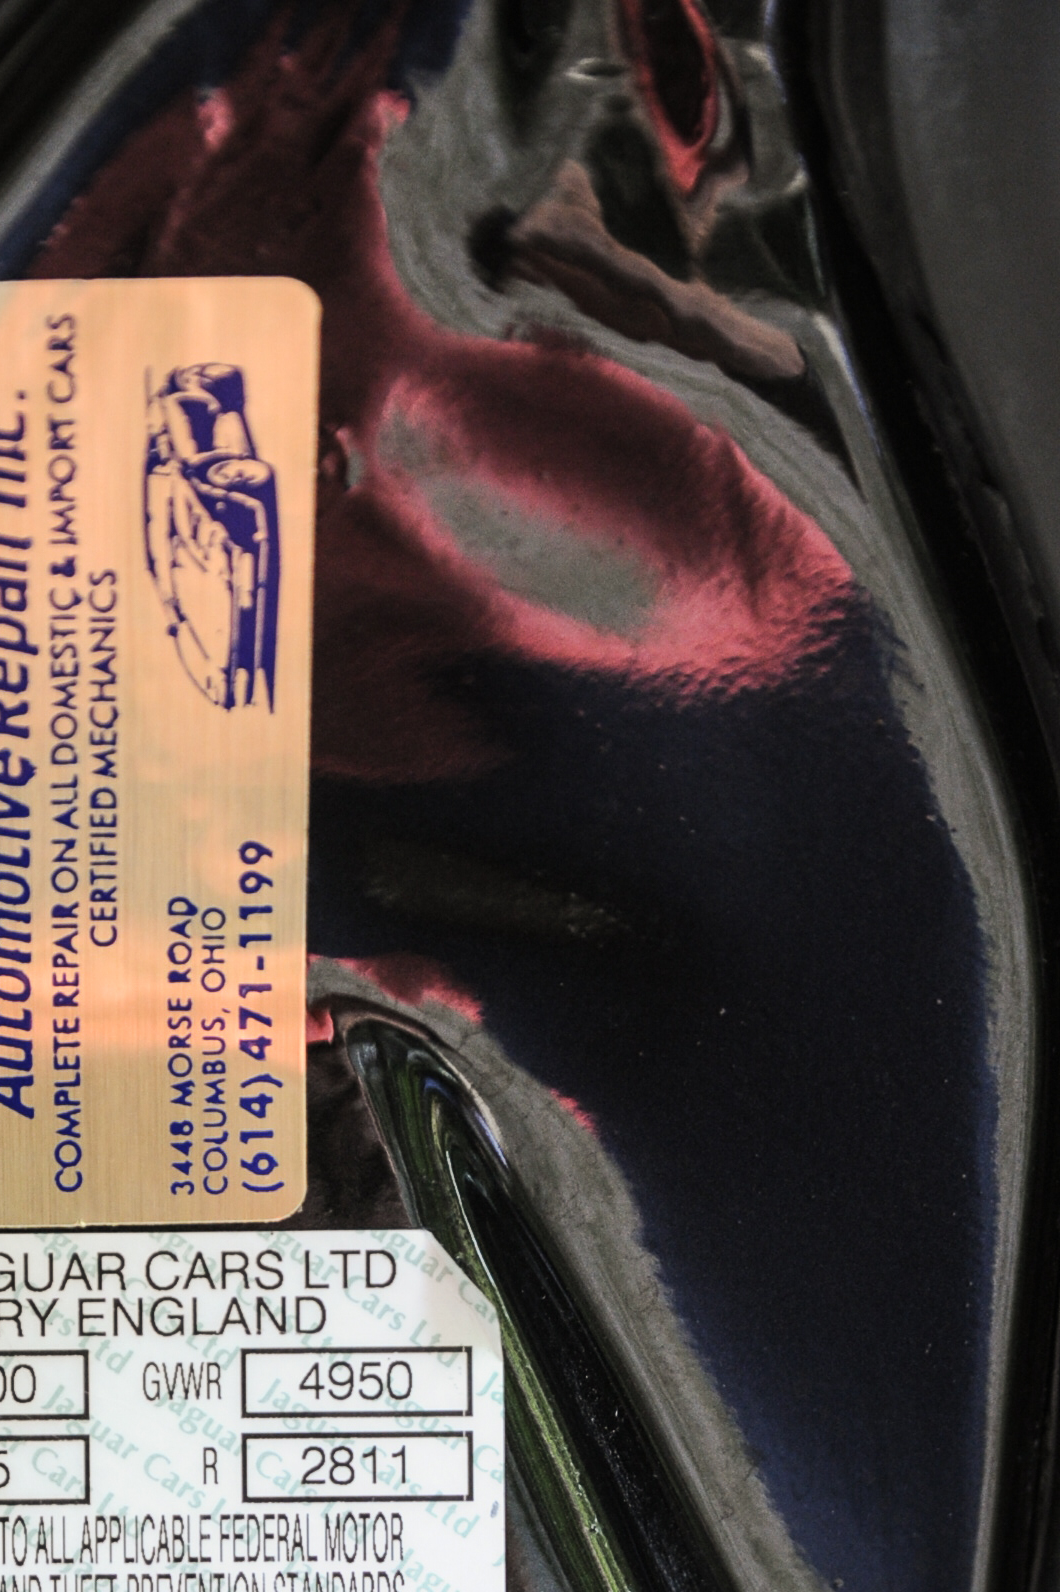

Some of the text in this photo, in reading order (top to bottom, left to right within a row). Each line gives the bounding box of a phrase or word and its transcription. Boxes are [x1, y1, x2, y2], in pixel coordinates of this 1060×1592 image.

[47, 311, 83, 1193] COMPLETE REPAIR ON ALL DOMESTIC & IMPORT CARS
[89, 570, 120, 947] CERTIFIED MECHANICS
[167, 896, 196, 1195] 3448 MORSE ROAD
[200, 907, 230, 1196] COLUMBUS, OHIO
[238, 840, 285, 1193] (614) 471-1199
[78, 1296, 327, 1337] ENGLAND
[145, 1249, 284, 1292] CARS
[304, 1249, 397, 1289] LTD
[142, 1360, 413, 1402] GVWR 4950
[203, 1445, 406, 1486] R 2811
[34, 1516, 75, 1564] ALL
[79, 1514, 212, 1566] APPLICABLE
[219, 1513, 318, 1563] FEDERAL
[324, 1511, 404, 1564] MOTOR
